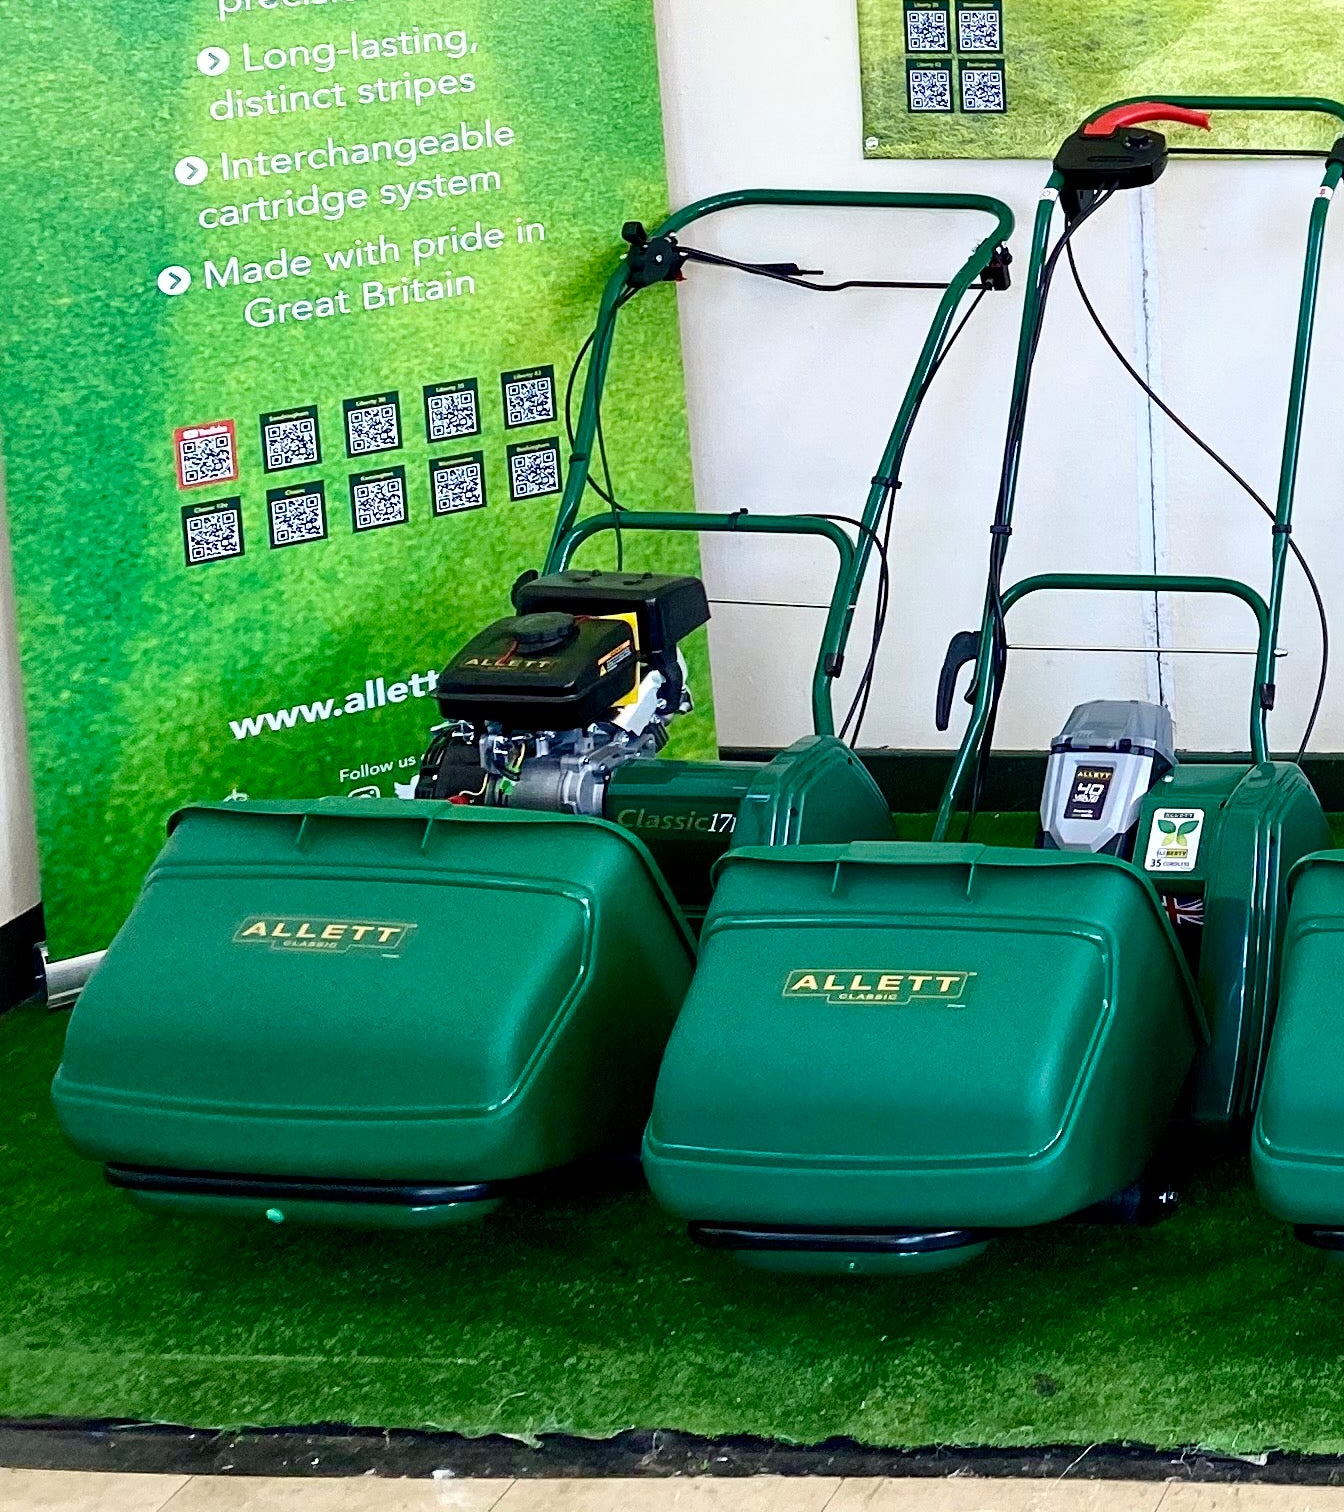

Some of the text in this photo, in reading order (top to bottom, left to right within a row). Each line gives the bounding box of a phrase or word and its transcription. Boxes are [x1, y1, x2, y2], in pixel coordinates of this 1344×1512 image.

[242, 27, 478, 72] Long-lasting,
[210, 73, 477, 122] distinct stripes
[221, 120, 516, 180] Interchangeable
[199, 170, 502, 229] cartridge system
[204, 219, 546, 290] Made with pride in
[244, 272, 476, 329] Great Britain
[229, 670, 440, 739] www.allett
[340, 755, 418, 784] Follow us
[1078, 783, 1105, 796] 40
[241, 921, 401, 943] ALLETT
[791, 974, 960, 992] ALLETT
